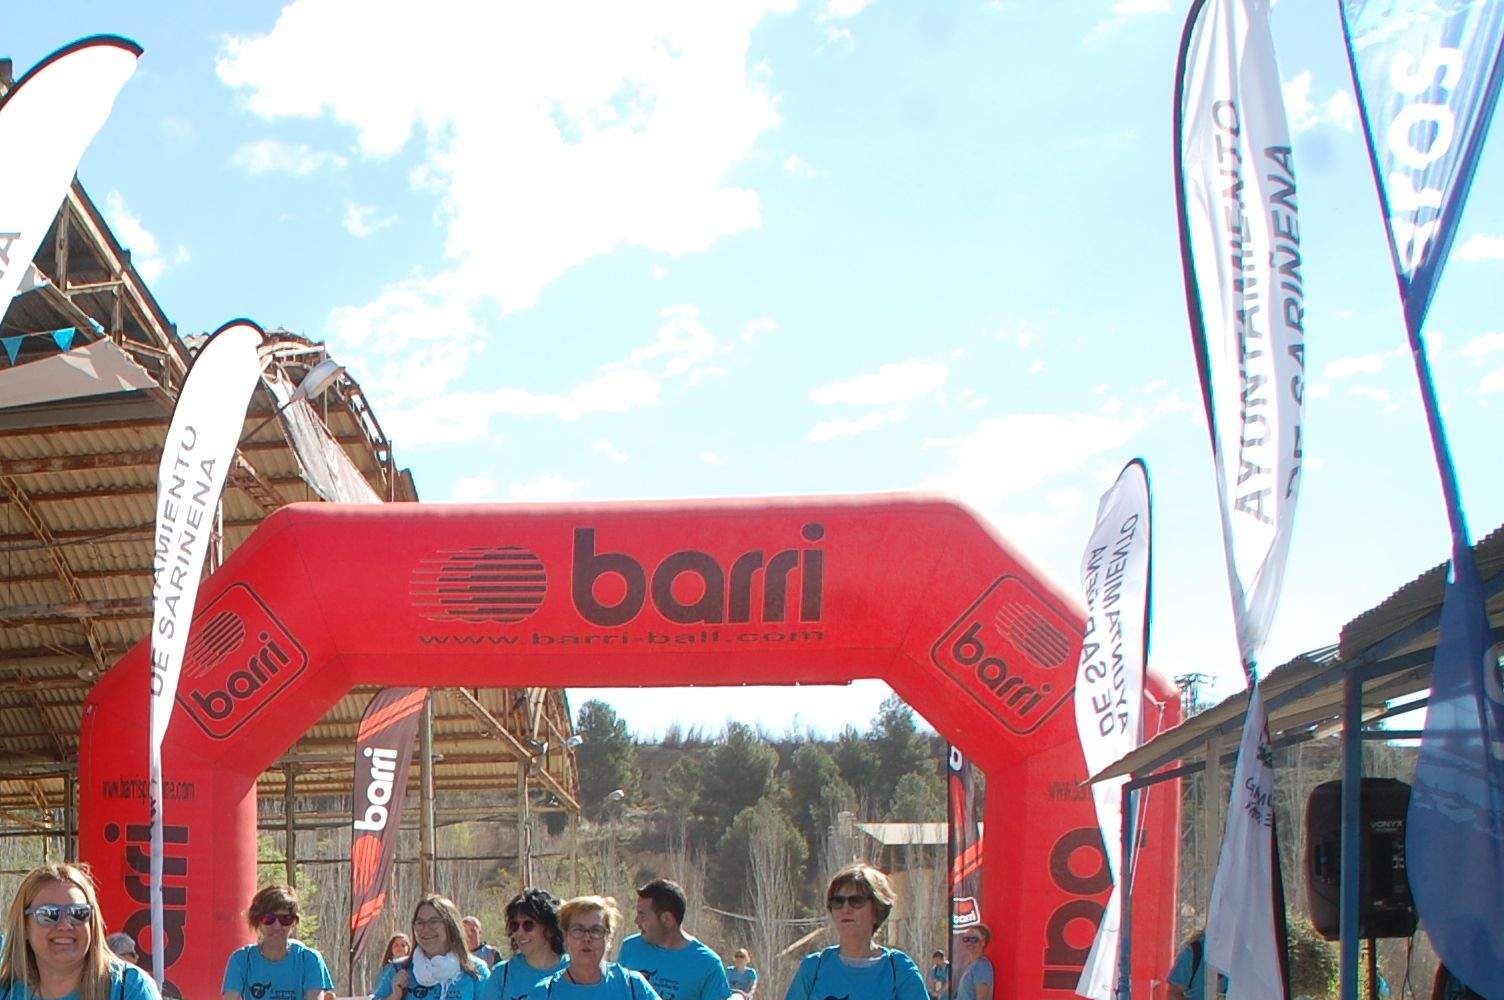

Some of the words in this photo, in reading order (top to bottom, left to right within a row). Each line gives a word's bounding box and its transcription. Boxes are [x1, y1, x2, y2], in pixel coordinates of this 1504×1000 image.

[158, 457, 217, 640] SARIÑENA
[571, 521, 826, 628] barri
[190, 630, 292, 720] barri
[419, 630, 826, 646] www.barri-ball.com
[951, 621, 1053, 716] barri
[353, 746, 398, 832] barri
